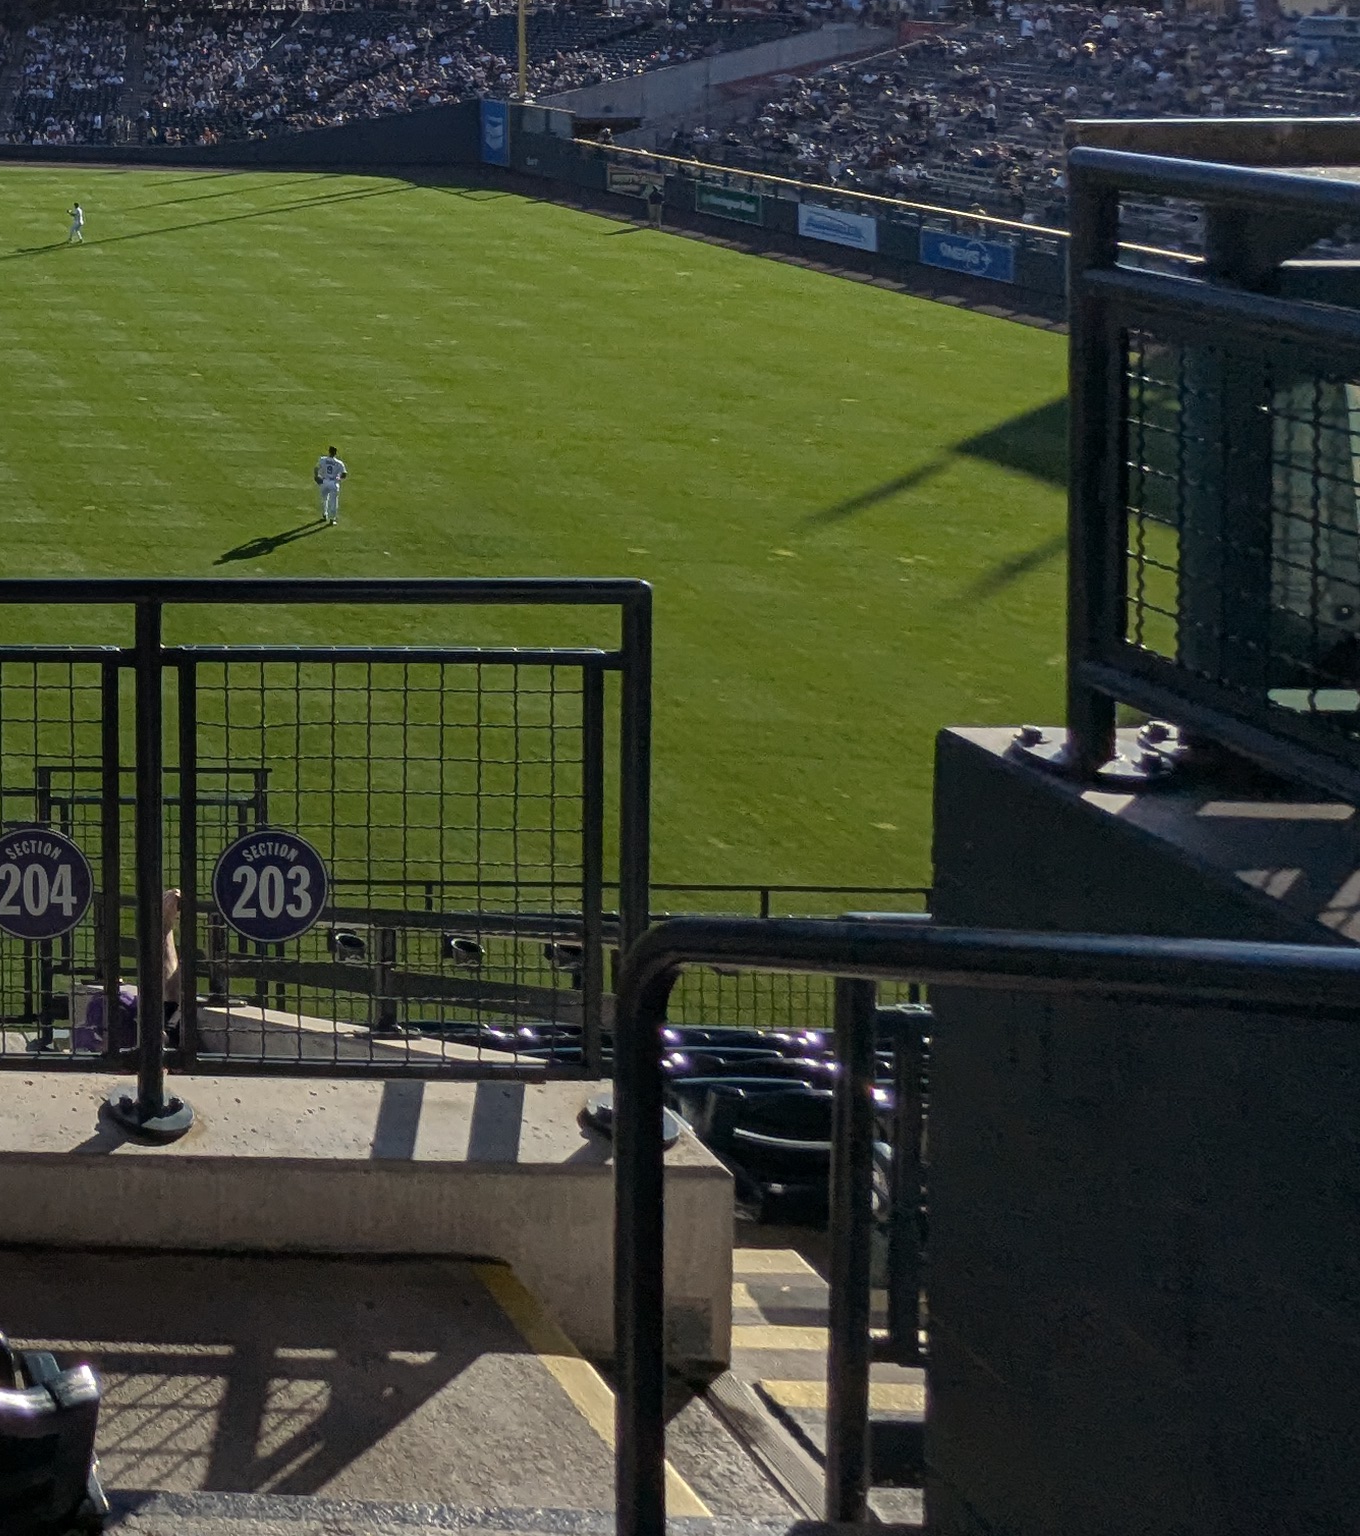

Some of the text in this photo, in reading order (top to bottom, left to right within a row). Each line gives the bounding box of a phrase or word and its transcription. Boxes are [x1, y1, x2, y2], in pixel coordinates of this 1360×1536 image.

[4, 841, 63, 861] SECTION
[242, 841, 299, 862] SECTION
[232, 865, 313, 919] 203
